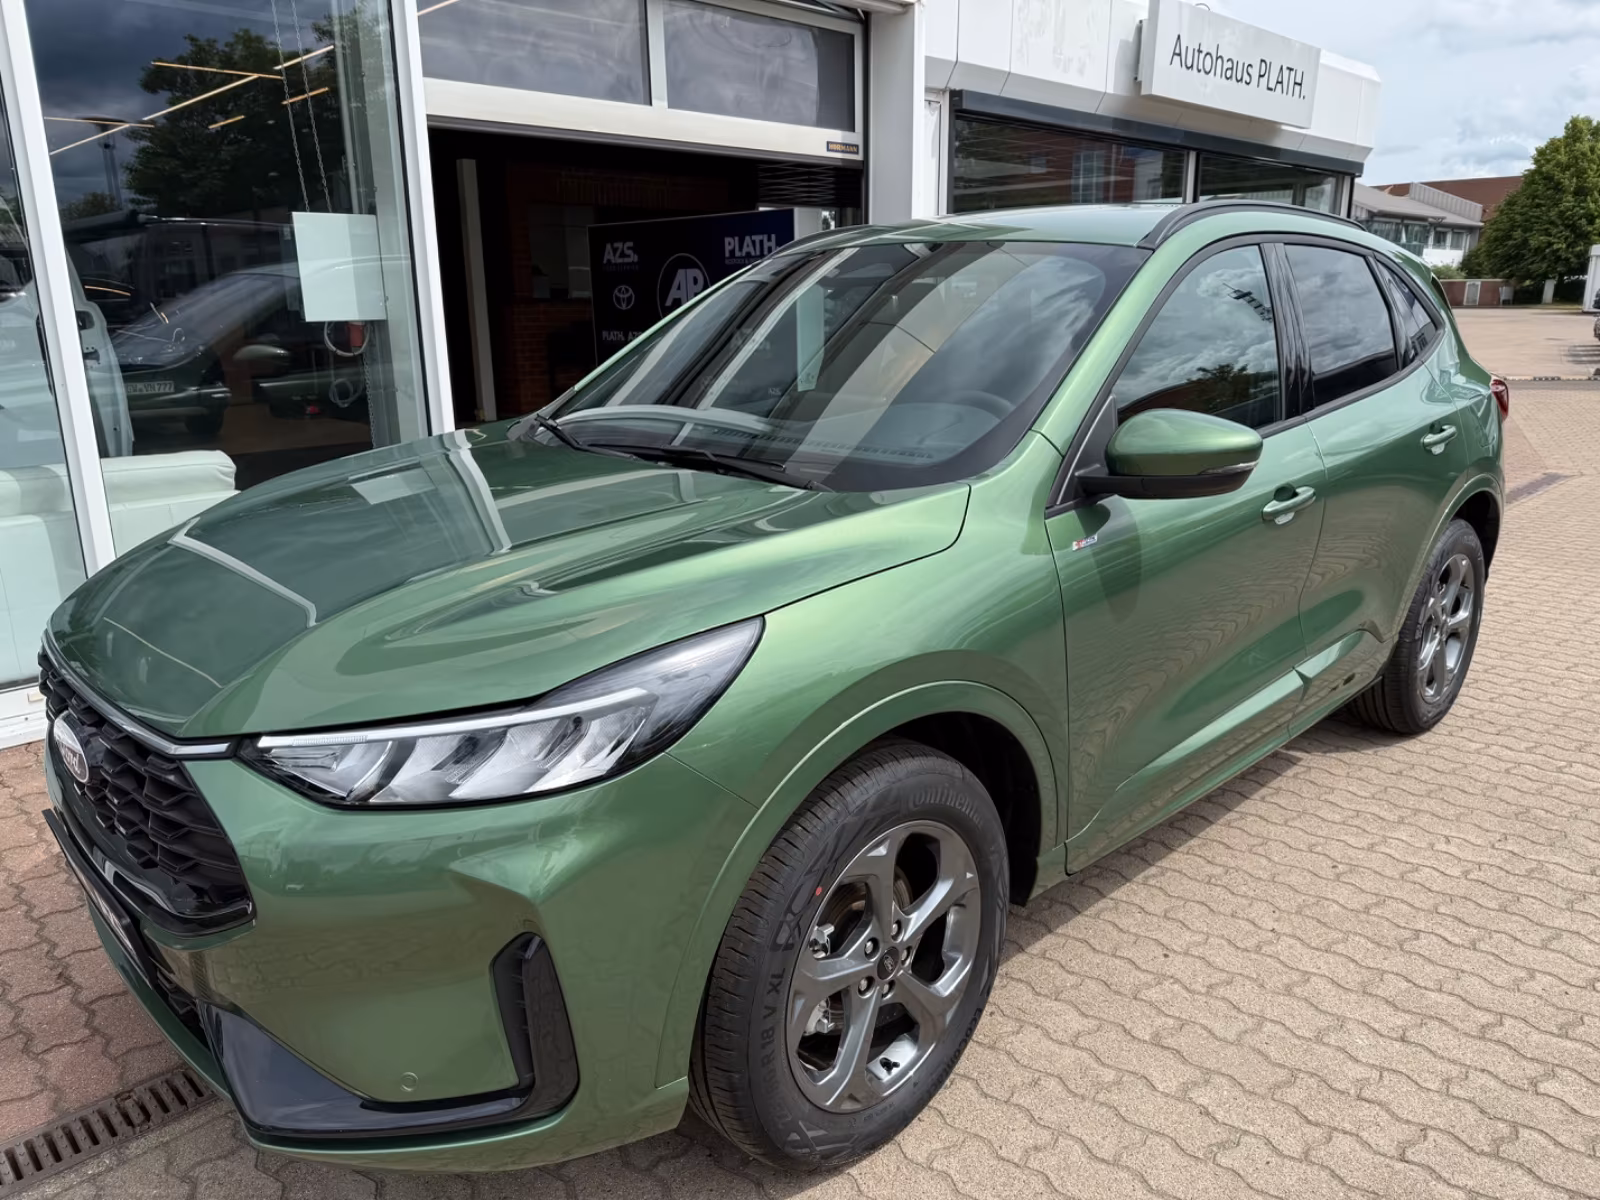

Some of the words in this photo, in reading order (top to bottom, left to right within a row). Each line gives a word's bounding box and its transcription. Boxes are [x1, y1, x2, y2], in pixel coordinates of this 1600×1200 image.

[1170, 34, 1253, 86] Autohaus
[1257, 58, 1306, 100] PLATH.
[603, 241, 639, 264] AZS.
[665, 268, 705, 307] AP
